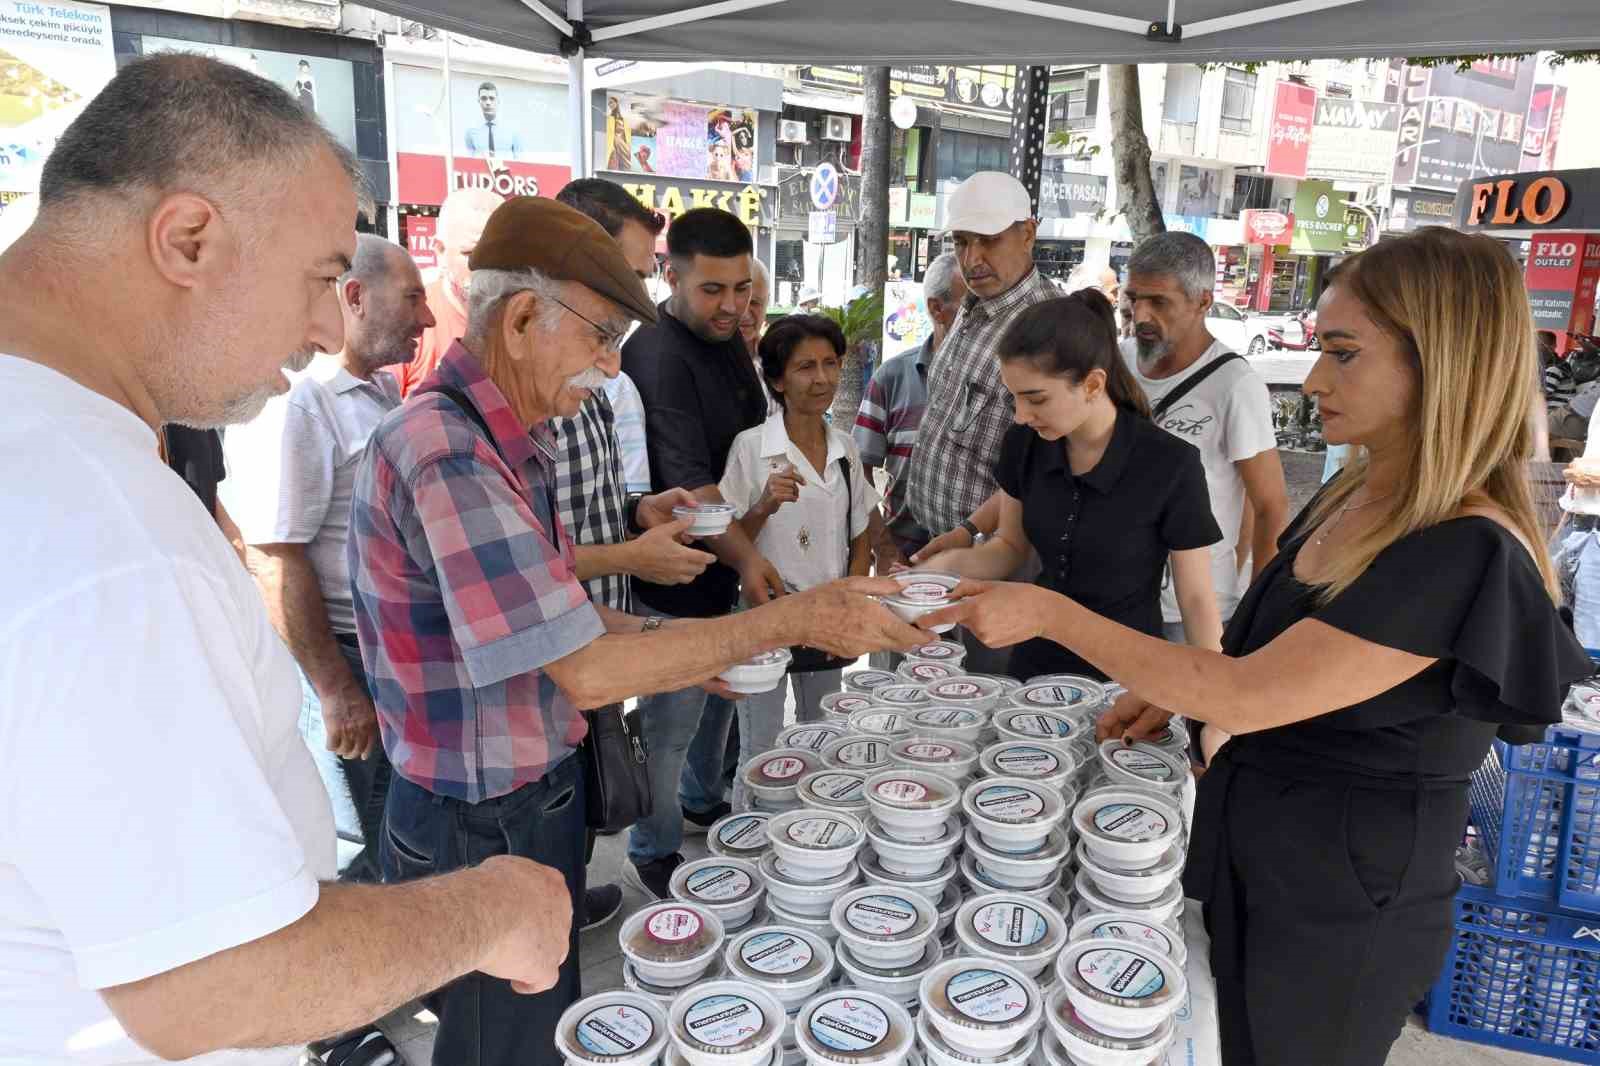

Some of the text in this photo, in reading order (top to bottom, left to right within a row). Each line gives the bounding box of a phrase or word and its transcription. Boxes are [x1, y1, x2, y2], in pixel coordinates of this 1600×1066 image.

[452, 172, 538, 196] TUDORS
[1467, 176, 1566, 226] FLO
[1536, 241, 1577, 257] FLO
[1535, 258, 1571, 267] OUTLET
